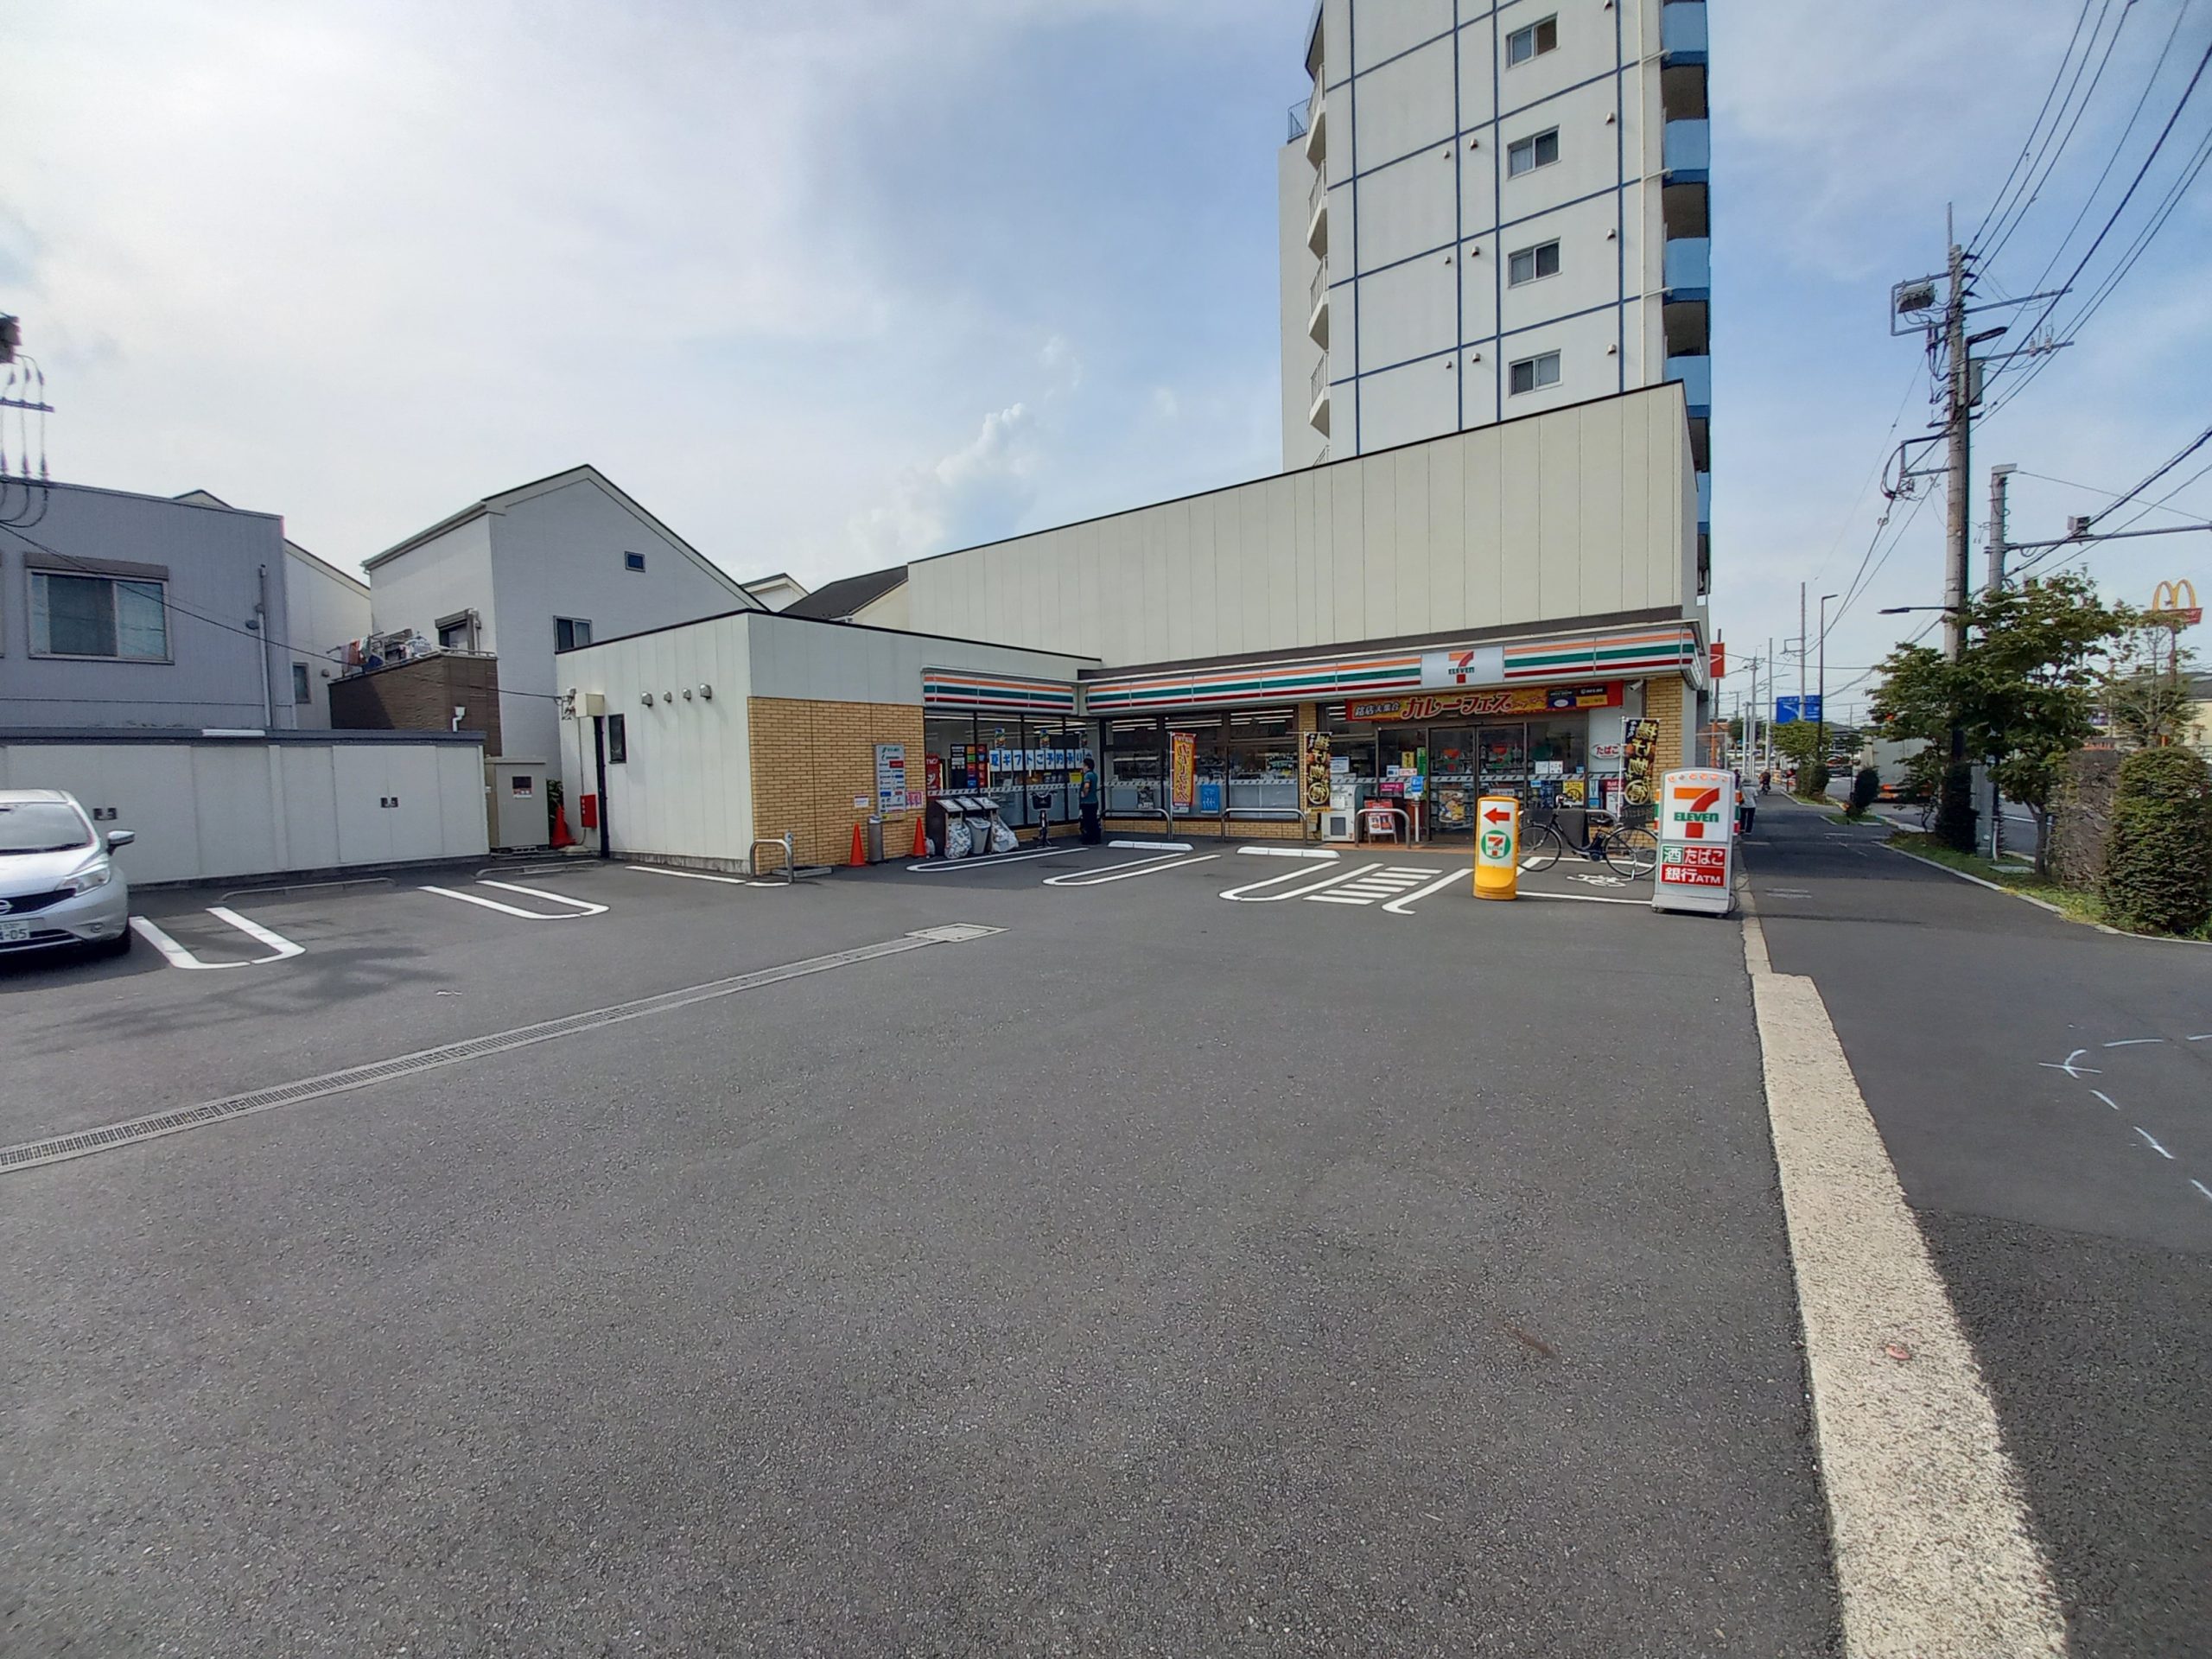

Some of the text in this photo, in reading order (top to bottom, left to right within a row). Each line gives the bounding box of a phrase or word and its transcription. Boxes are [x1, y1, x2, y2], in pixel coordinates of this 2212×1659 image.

[1448, 651, 1474, 684] 7
[1401, 693, 1512, 720] カレーフェス
[1596, 746, 1620, 755] たばこ
[1674, 787, 1720, 838] 7
[1663, 848, 1725, 867] 酒 たばこ
[1664, 866, 1721, 884] 銀行ATM
